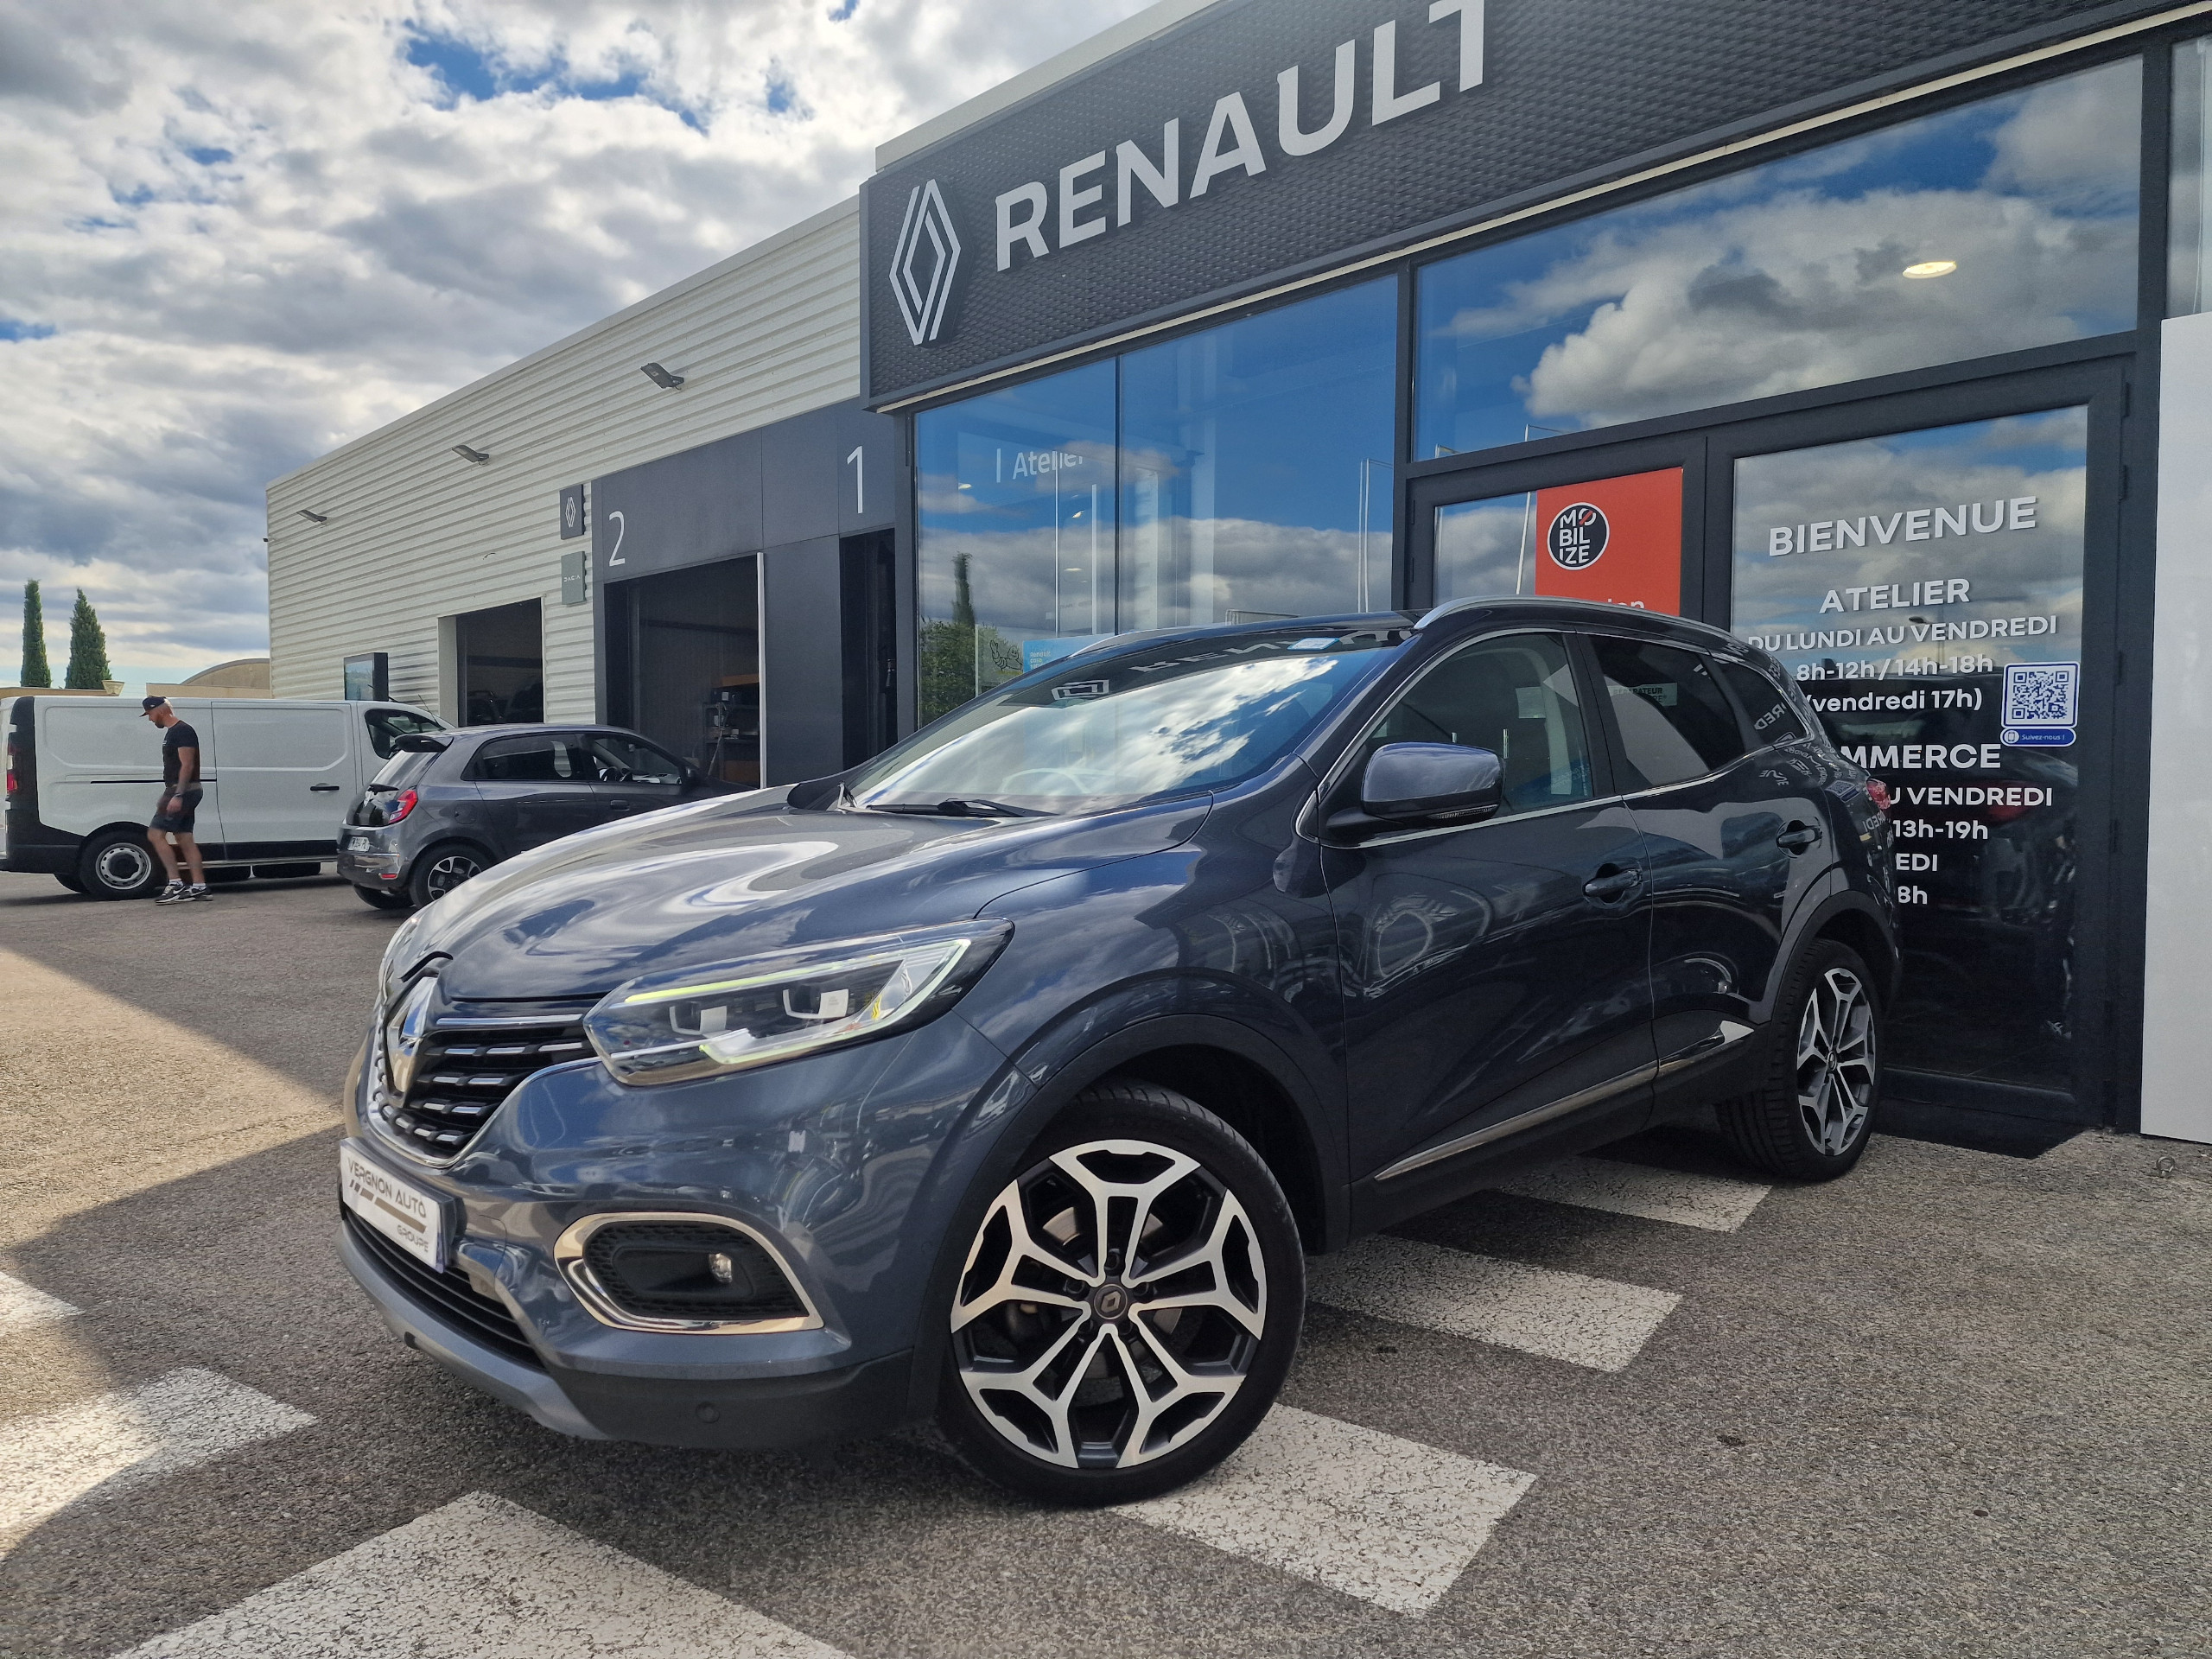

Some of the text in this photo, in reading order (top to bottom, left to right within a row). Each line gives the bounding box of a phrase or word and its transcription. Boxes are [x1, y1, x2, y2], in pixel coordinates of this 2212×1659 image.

[995, 0, 1484, 271] RENAULT
[846, 446, 864, 514] 1
[608, 511, 626, 567] 2
[1768, 495, 2037, 556] BIENVENUE
[1819, 578, 1970, 613] ATELIER
[1748, 614, 2057, 652] DU LUNDI AU VENDREDI
[1796, 662, 1875, 681] 8h-12h
[1896, 654, 1993, 677] 14h-18h
[1931, 688, 1983, 710] 17h)
[1840, 743, 2001, 769] MMERCE
[1906, 787, 2052, 806] VENDREDI
[1892, 819, 1988, 840] 13h-19h
[1895, 853, 1938, 872] EDI
[1897, 886, 1928, 905] 8h
[347, 1157, 392, 1199] VERGNON
[397, 1224, 429, 1253] GROUPE
